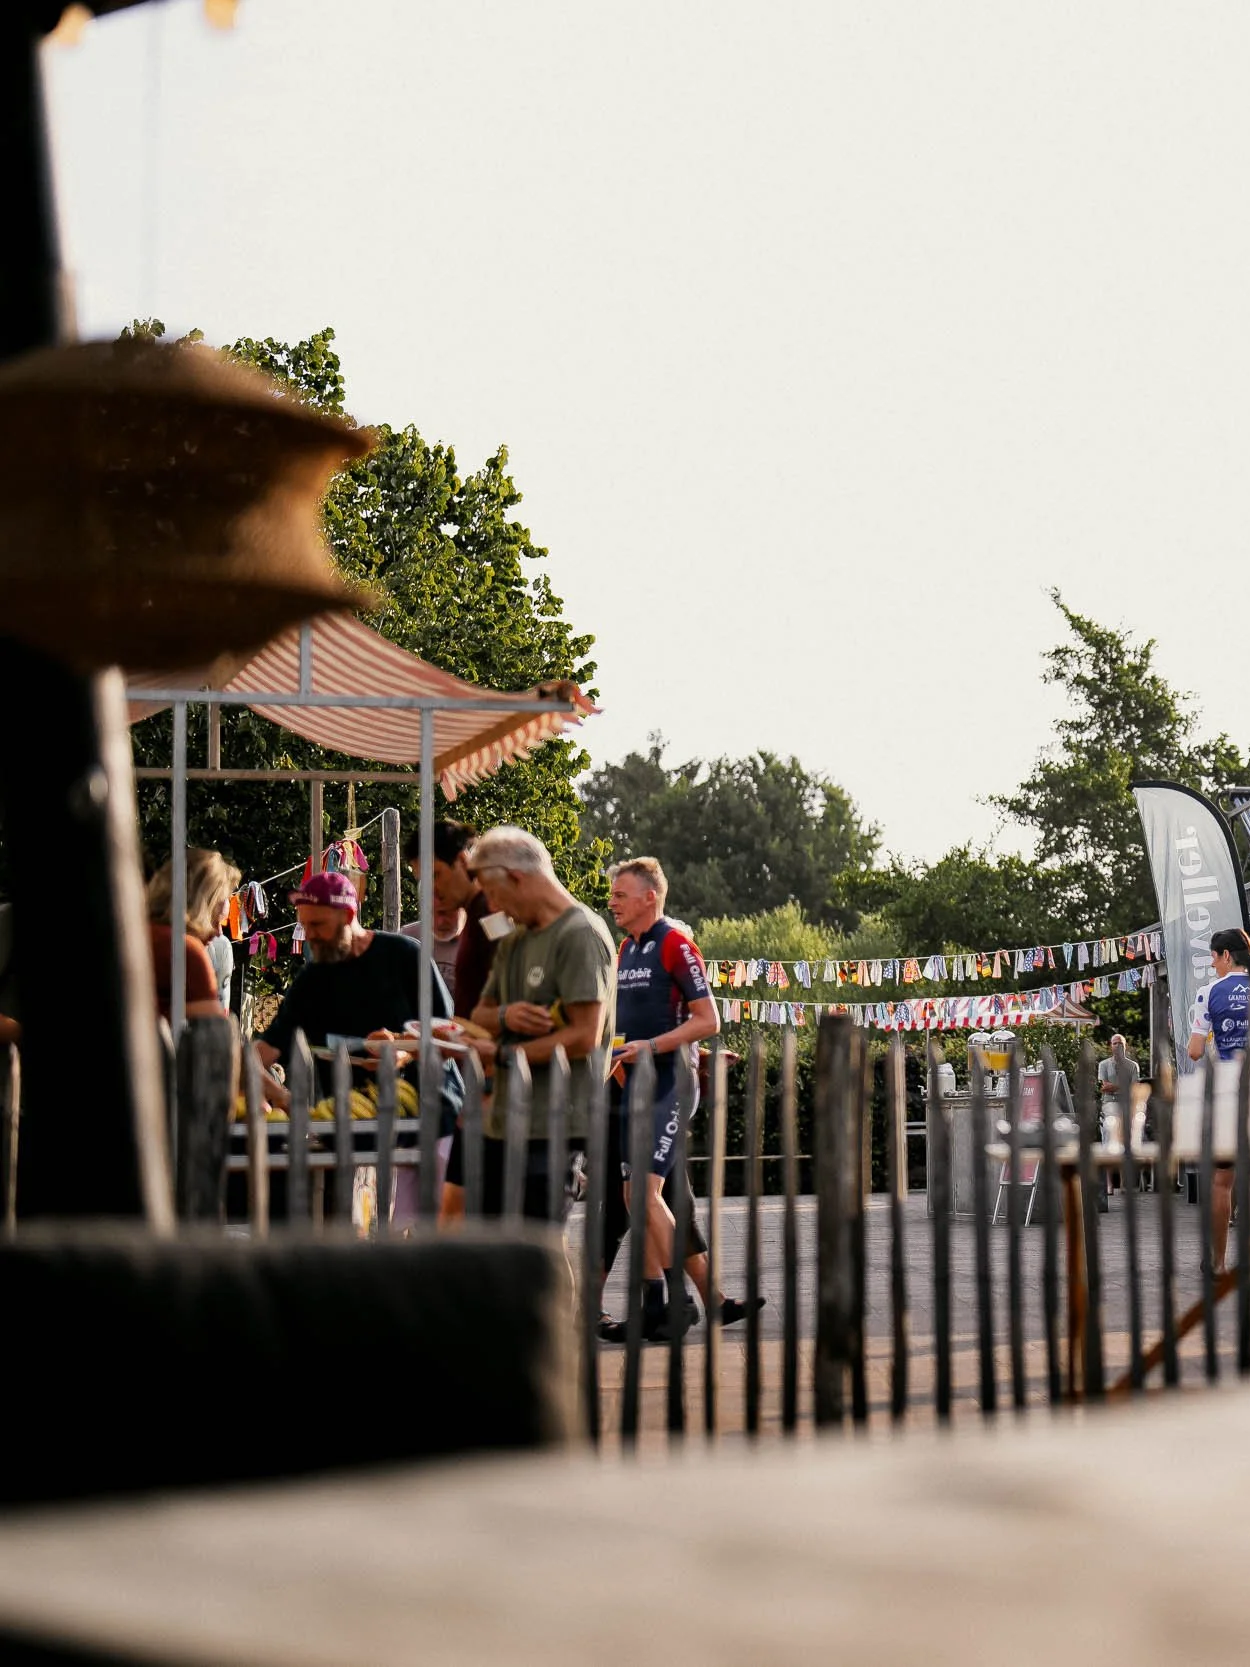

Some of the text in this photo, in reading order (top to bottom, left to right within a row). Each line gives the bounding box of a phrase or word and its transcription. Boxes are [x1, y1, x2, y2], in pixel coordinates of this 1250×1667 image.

[680, 943, 705, 991] Full Orbit
[653, 1135, 673, 1162] Full
